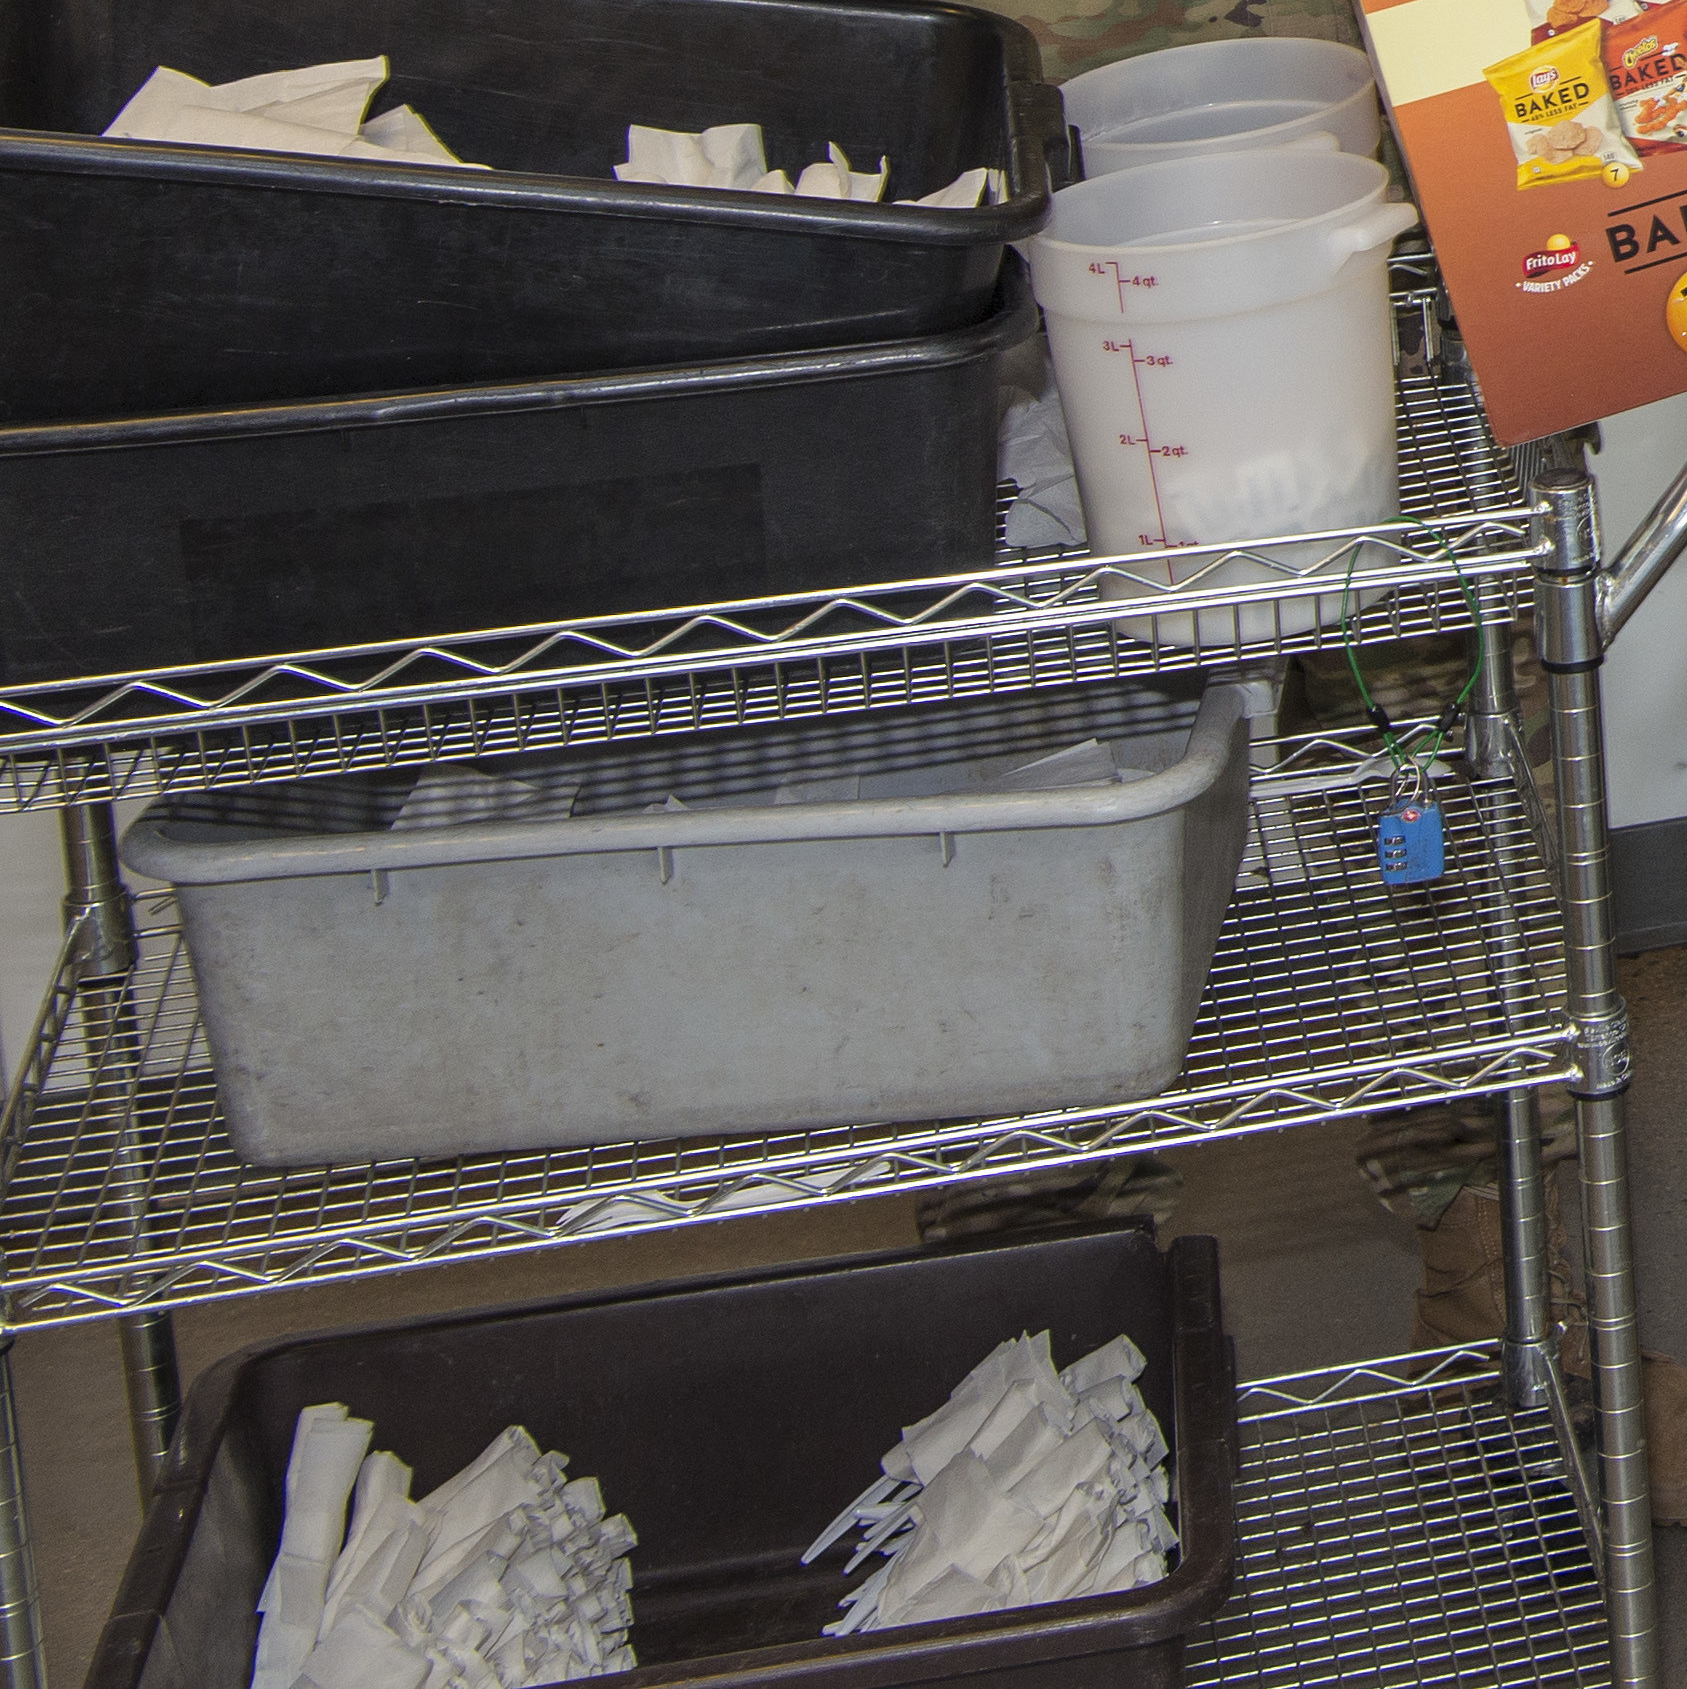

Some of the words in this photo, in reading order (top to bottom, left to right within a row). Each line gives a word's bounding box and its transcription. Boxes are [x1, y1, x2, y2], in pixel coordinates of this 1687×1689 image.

[1609, 52, 1687, 90] BAKED
[1514, 82, 1590, 118] BAKED
[1546, 107, 1563, 118] LESS
[1564, 104, 1578, 114] FAT
[1610, 168, 1620, 182] 7
[1522, 280, 1562, 293] VARIETY
[1562, 262, 1590, 287] PACKS
